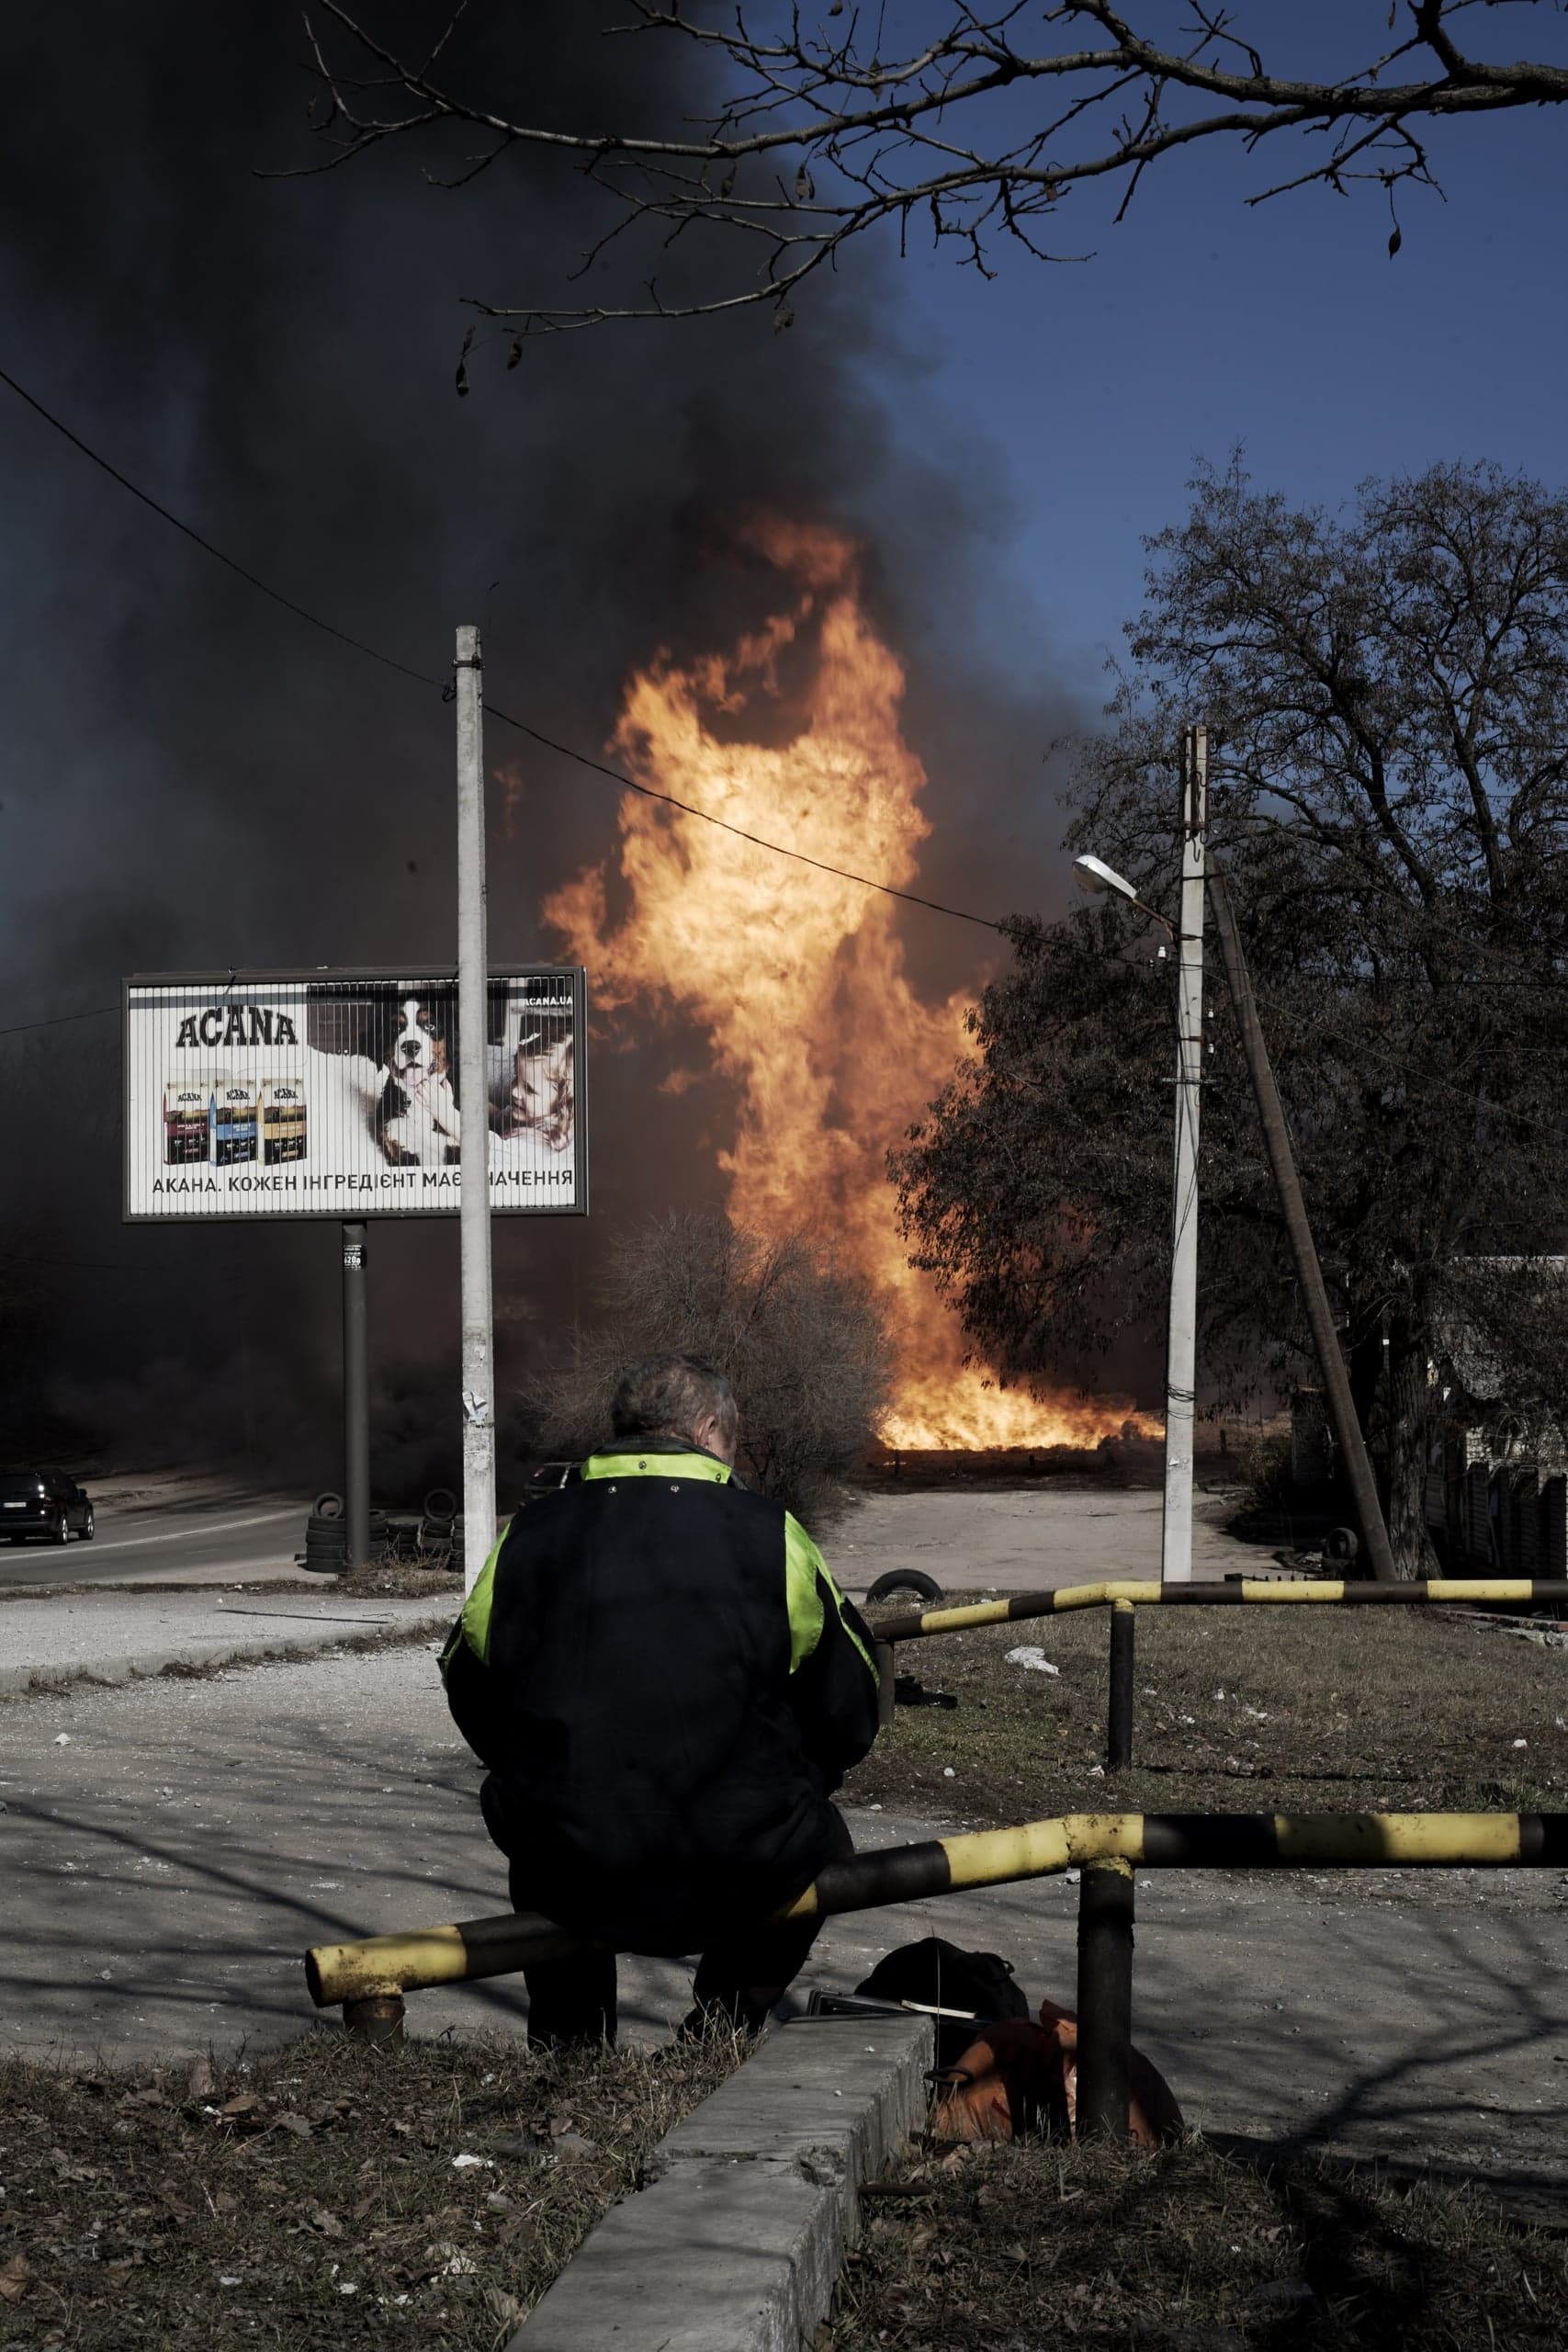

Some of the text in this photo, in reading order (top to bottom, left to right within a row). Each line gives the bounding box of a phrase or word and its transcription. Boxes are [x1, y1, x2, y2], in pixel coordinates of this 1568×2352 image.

[175, 1004, 299, 1047] ACANA
[152, 1177, 222, 1193] АКАНА.
[229, 1176, 298, 1192] КОЖЕН
[303, 1173, 417, 1193] ІНГРЕДІЄНТ
[423, 1172, 462, 1188] МАЄ
